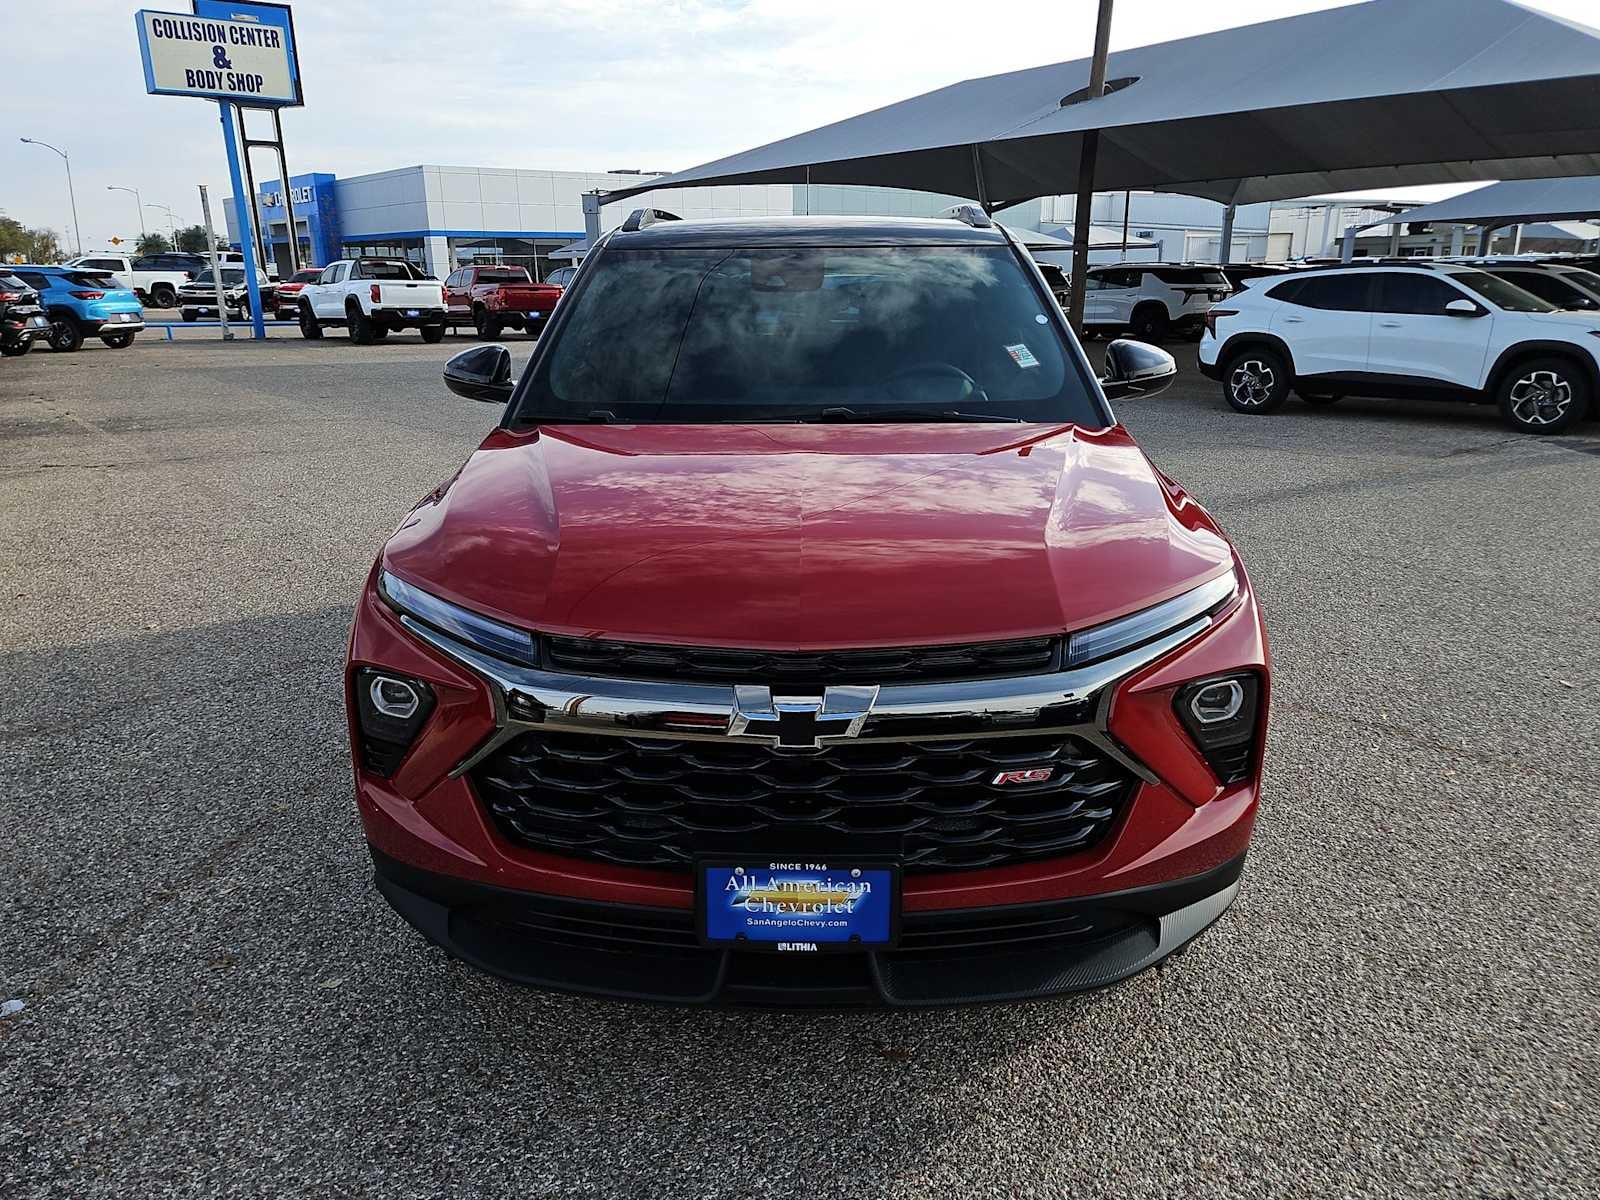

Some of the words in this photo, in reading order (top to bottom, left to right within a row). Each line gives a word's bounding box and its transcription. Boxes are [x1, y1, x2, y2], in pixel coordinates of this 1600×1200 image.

[153, 18, 227, 44] COLLISION
[230, 26, 280, 48] CENTER
[212, 45, 232, 69] &
[185, 69, 223, 90] BODY
[227, 73, 263, 93] SHOP
[992, 768, 1054, 784] RS
[769, 862, 801, 871] SINCE
[805, 863, 827, 871] 1946
[725, 875, 756, 891] All
[766, 877, 872, 893] American
[744, 897, 854, 914] Chevrolet
[746, 918, 848, 927] SanAngeloChevy.com
[787, 943, 818, 951] LITHIA
